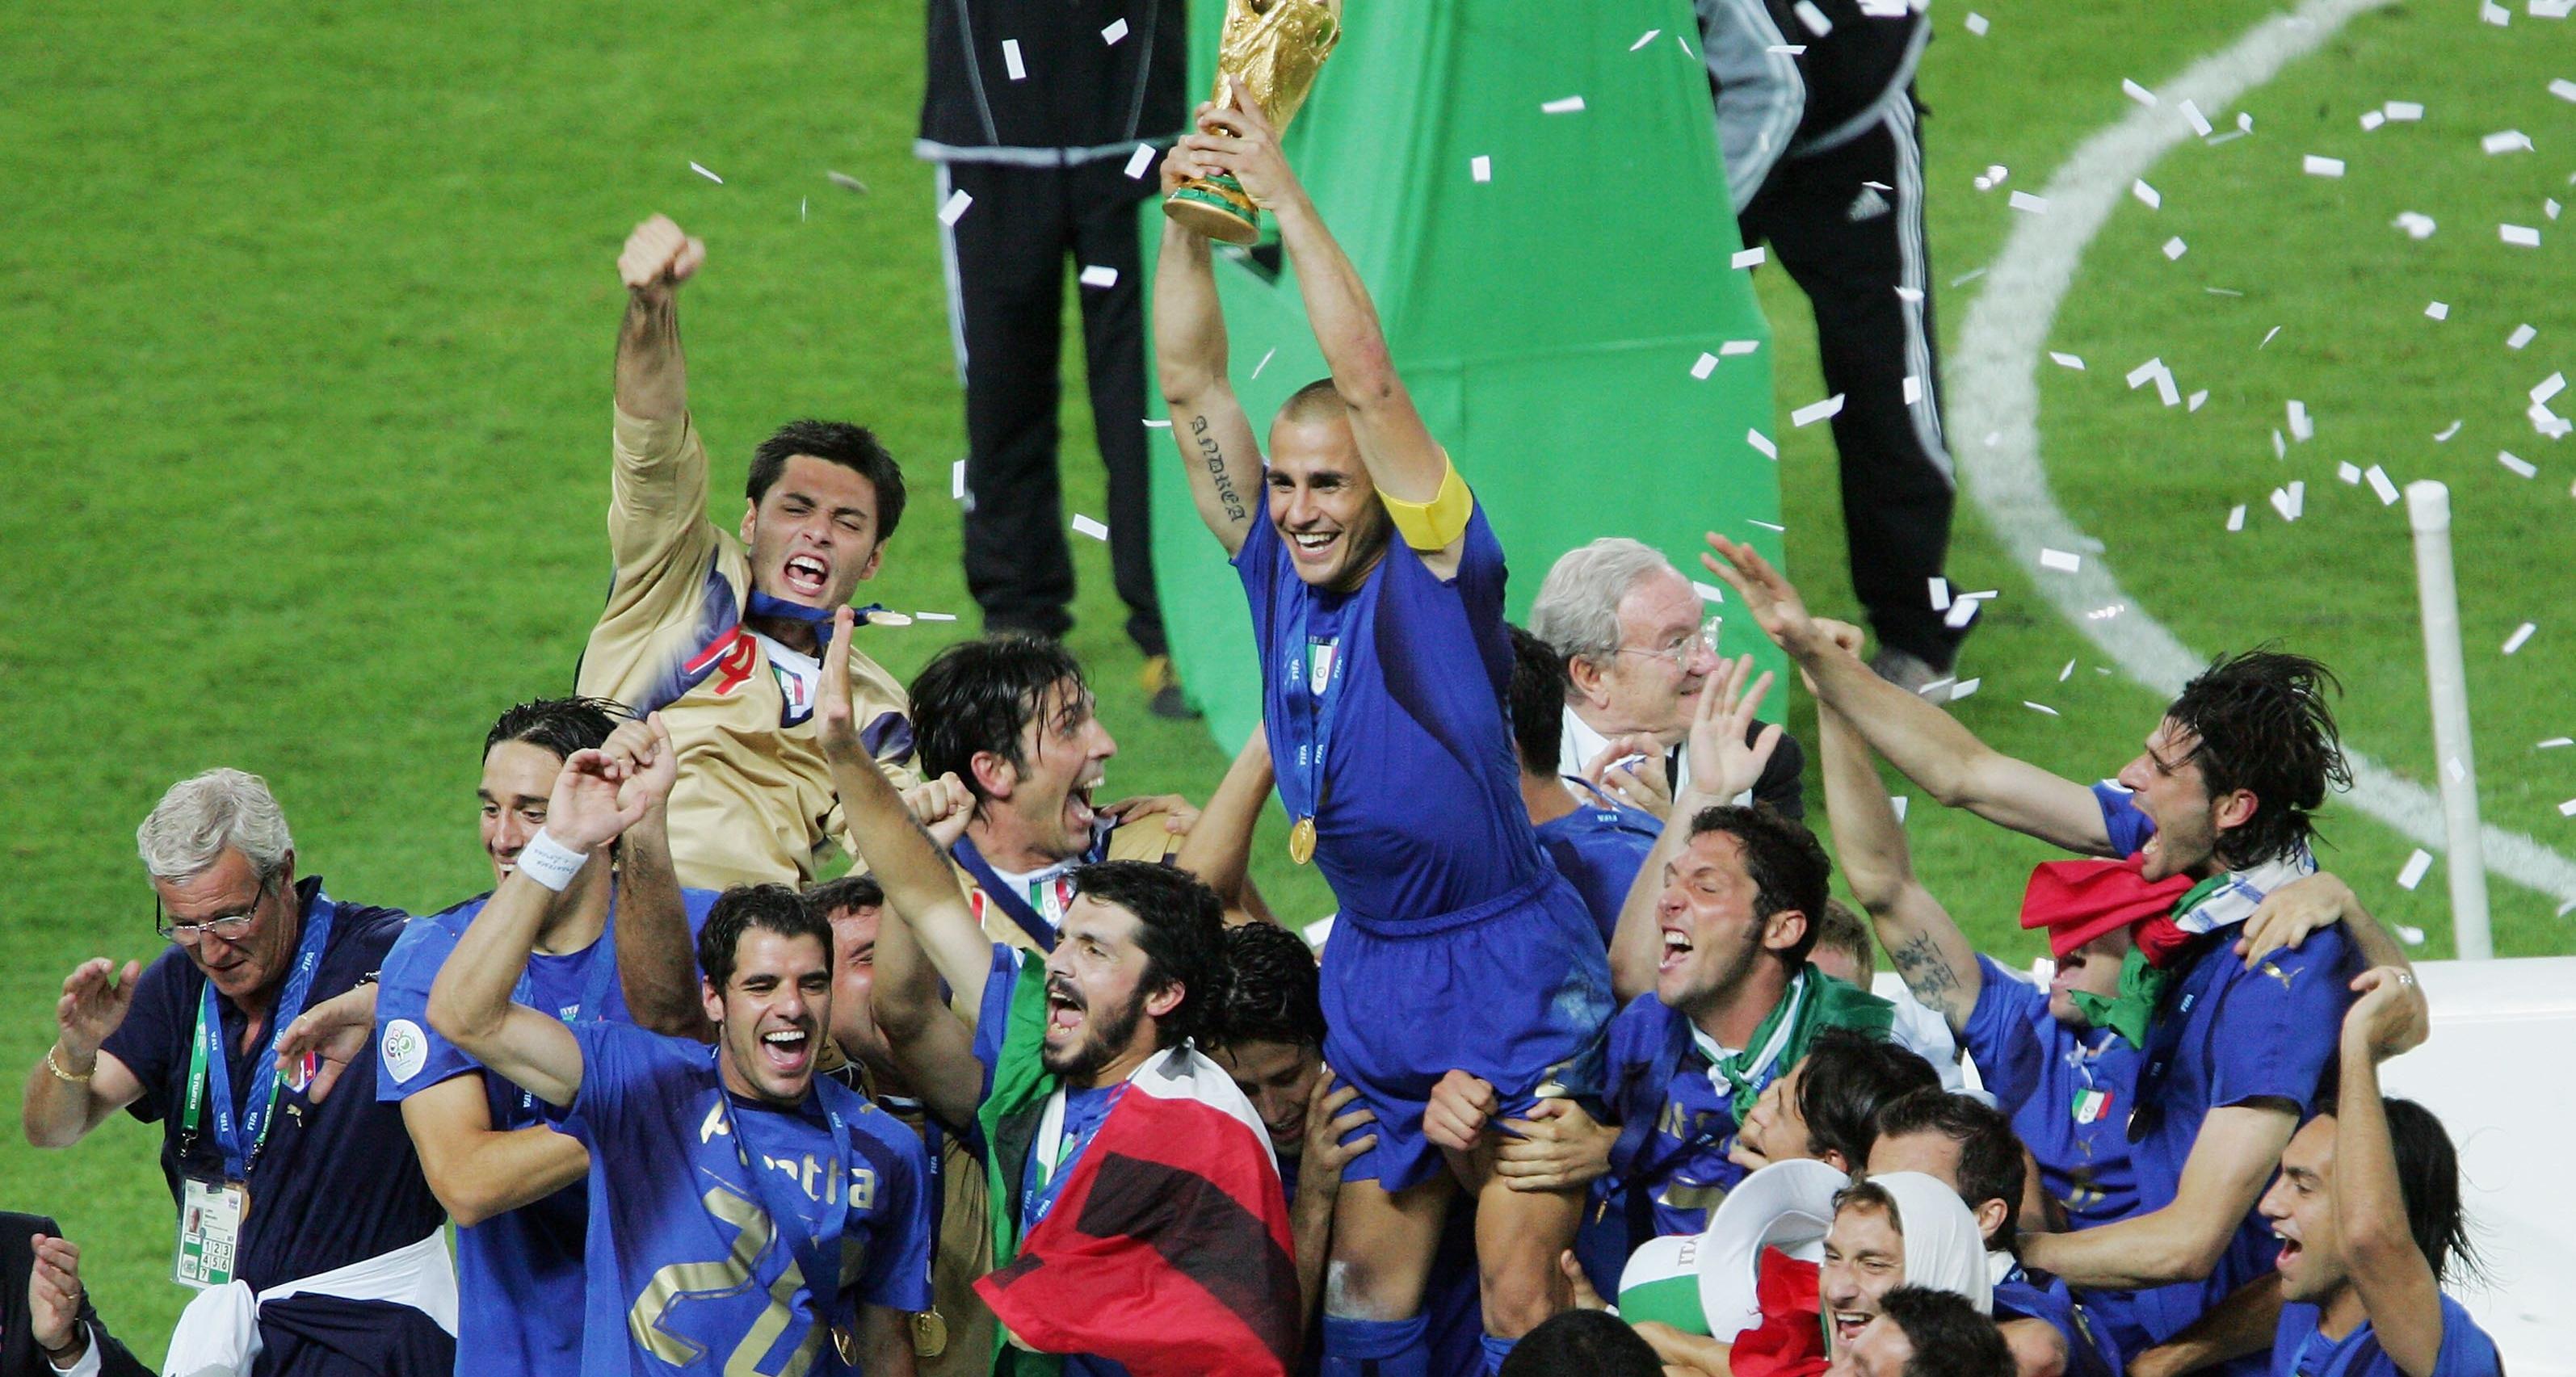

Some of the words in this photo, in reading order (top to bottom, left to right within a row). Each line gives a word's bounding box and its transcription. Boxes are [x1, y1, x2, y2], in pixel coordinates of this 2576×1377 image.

[1189, 415, 1246, 522] ANDREA
[1292, 659, 1300, 680] FIFA
[1334, 656, 1343, 678] FIFA
[1300, 745, 1308, 766] FIFA
[1314, 744, 1324, 765] FIFA
[302, 951, 315, 971] FIFA
[2181, 993, 2195, 1013] FIFA
[220, 1111, 229, 1132] FIFA
[246, 1111, 258, 1131] FIFA
[700, 1099, 876, 1210] Ptta
[930, 1155, 938, 1175] FIFA
[1037, 1199, 1051, 1218] FIFA
[205, 1241, 210, 1250] 1
[214, 1244, 220, 1253] 2
[223, 1245, 229, 1256] 3
[202, 1254, 208, 1265] 4
[212, 1257, 217, 1267] 5
[221, 1259, 227, 1270] 6
[202, 1269, 207, 1278] 7
